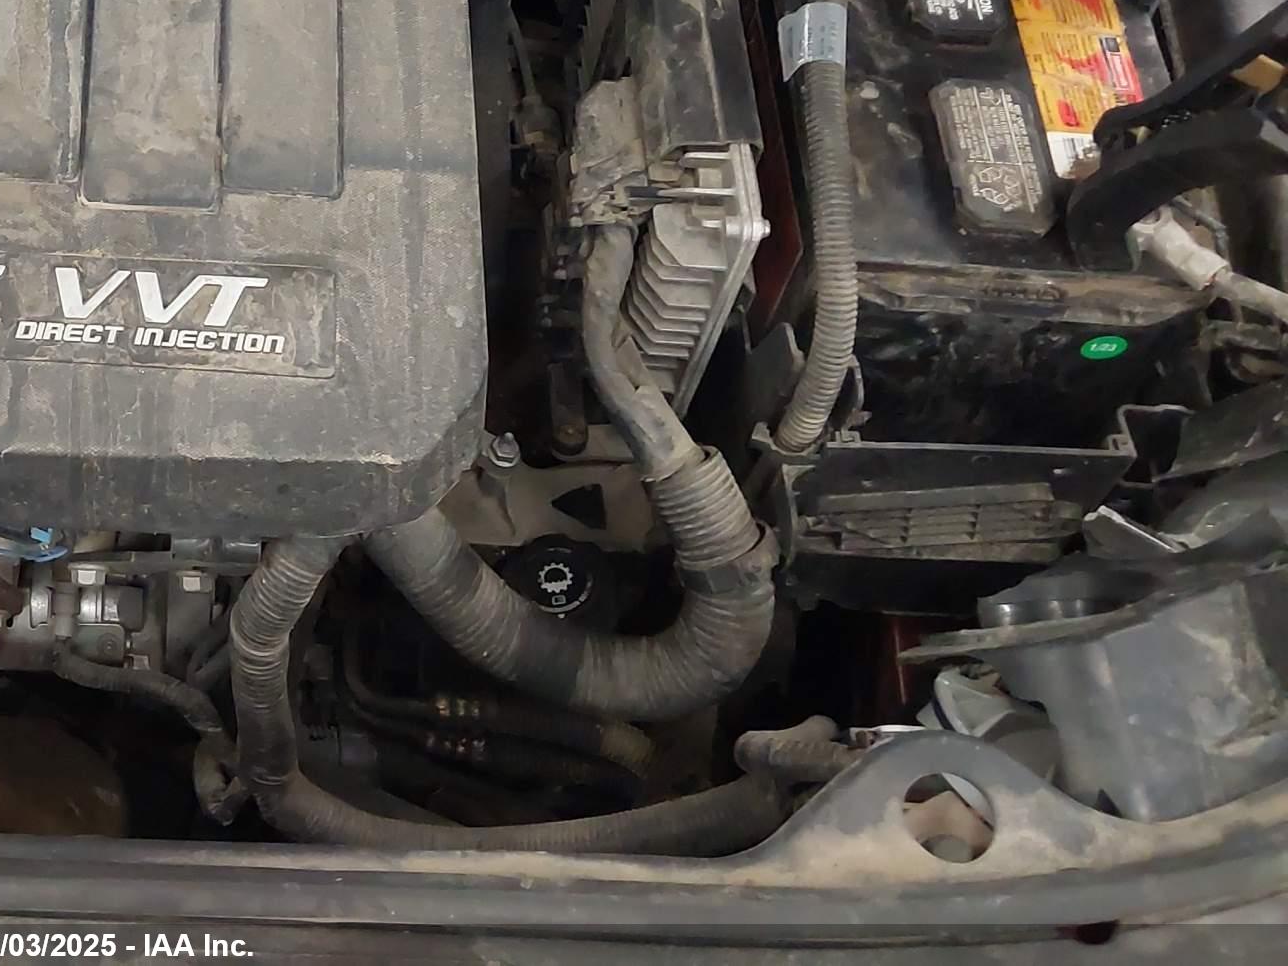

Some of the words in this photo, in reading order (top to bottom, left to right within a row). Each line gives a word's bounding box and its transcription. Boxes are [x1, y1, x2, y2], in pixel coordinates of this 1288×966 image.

[55, 267, 269, 327] VVT
[15, 320, 124, 343] DIRECT
[133, 328, 285, 354] INJECTION
